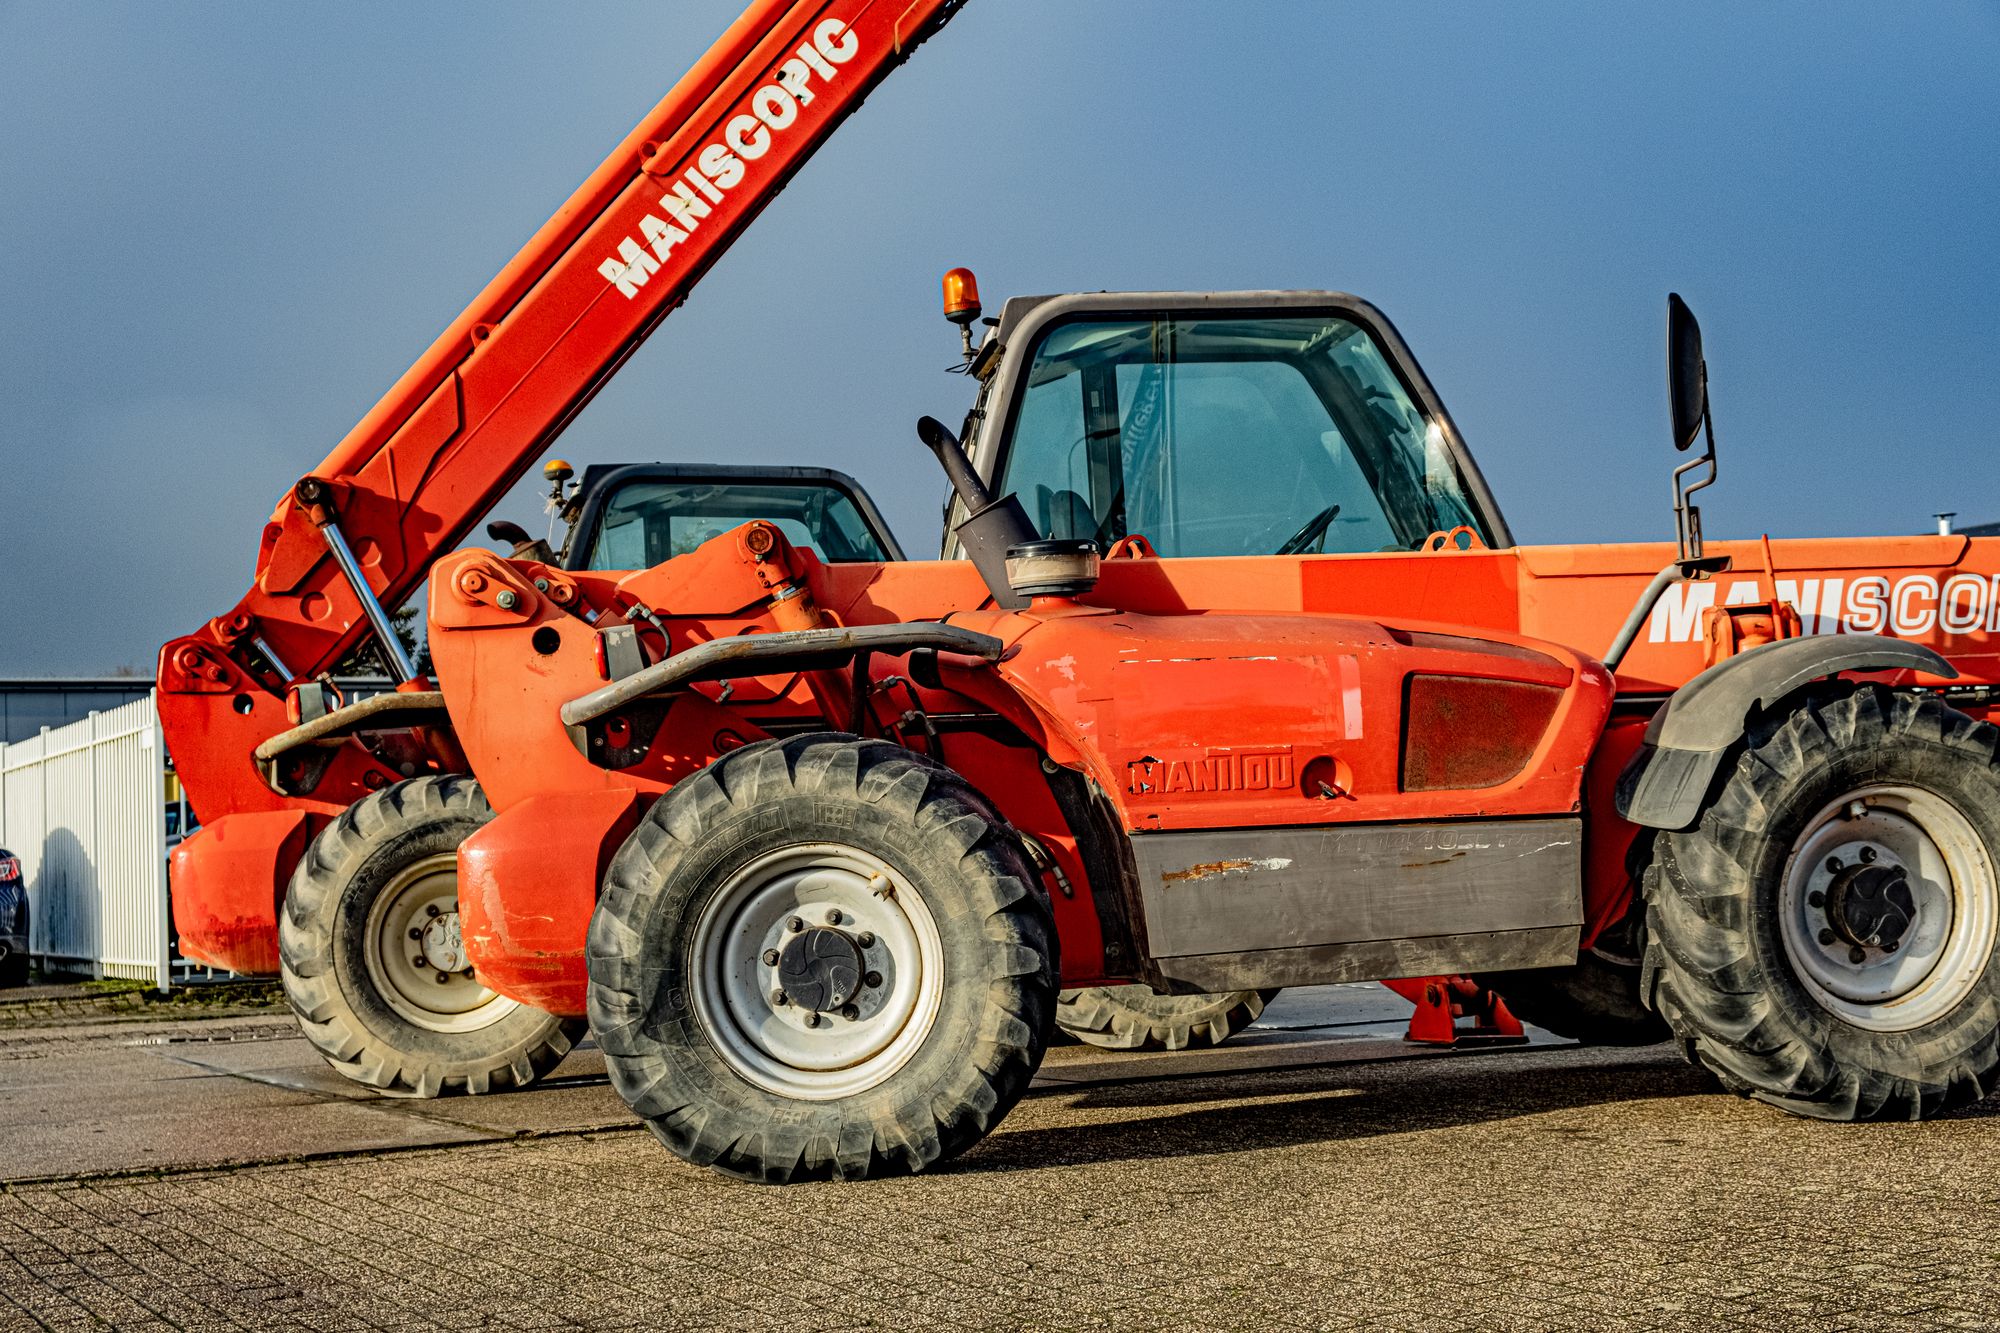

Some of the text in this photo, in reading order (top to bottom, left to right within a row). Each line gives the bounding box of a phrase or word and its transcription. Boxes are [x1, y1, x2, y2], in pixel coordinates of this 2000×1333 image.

[597, 18, 859, 300] MANISCOPIC
[1648, 573, 2000, 643] MNISCO
[1131, 745, 1295, 794] MANITOU
